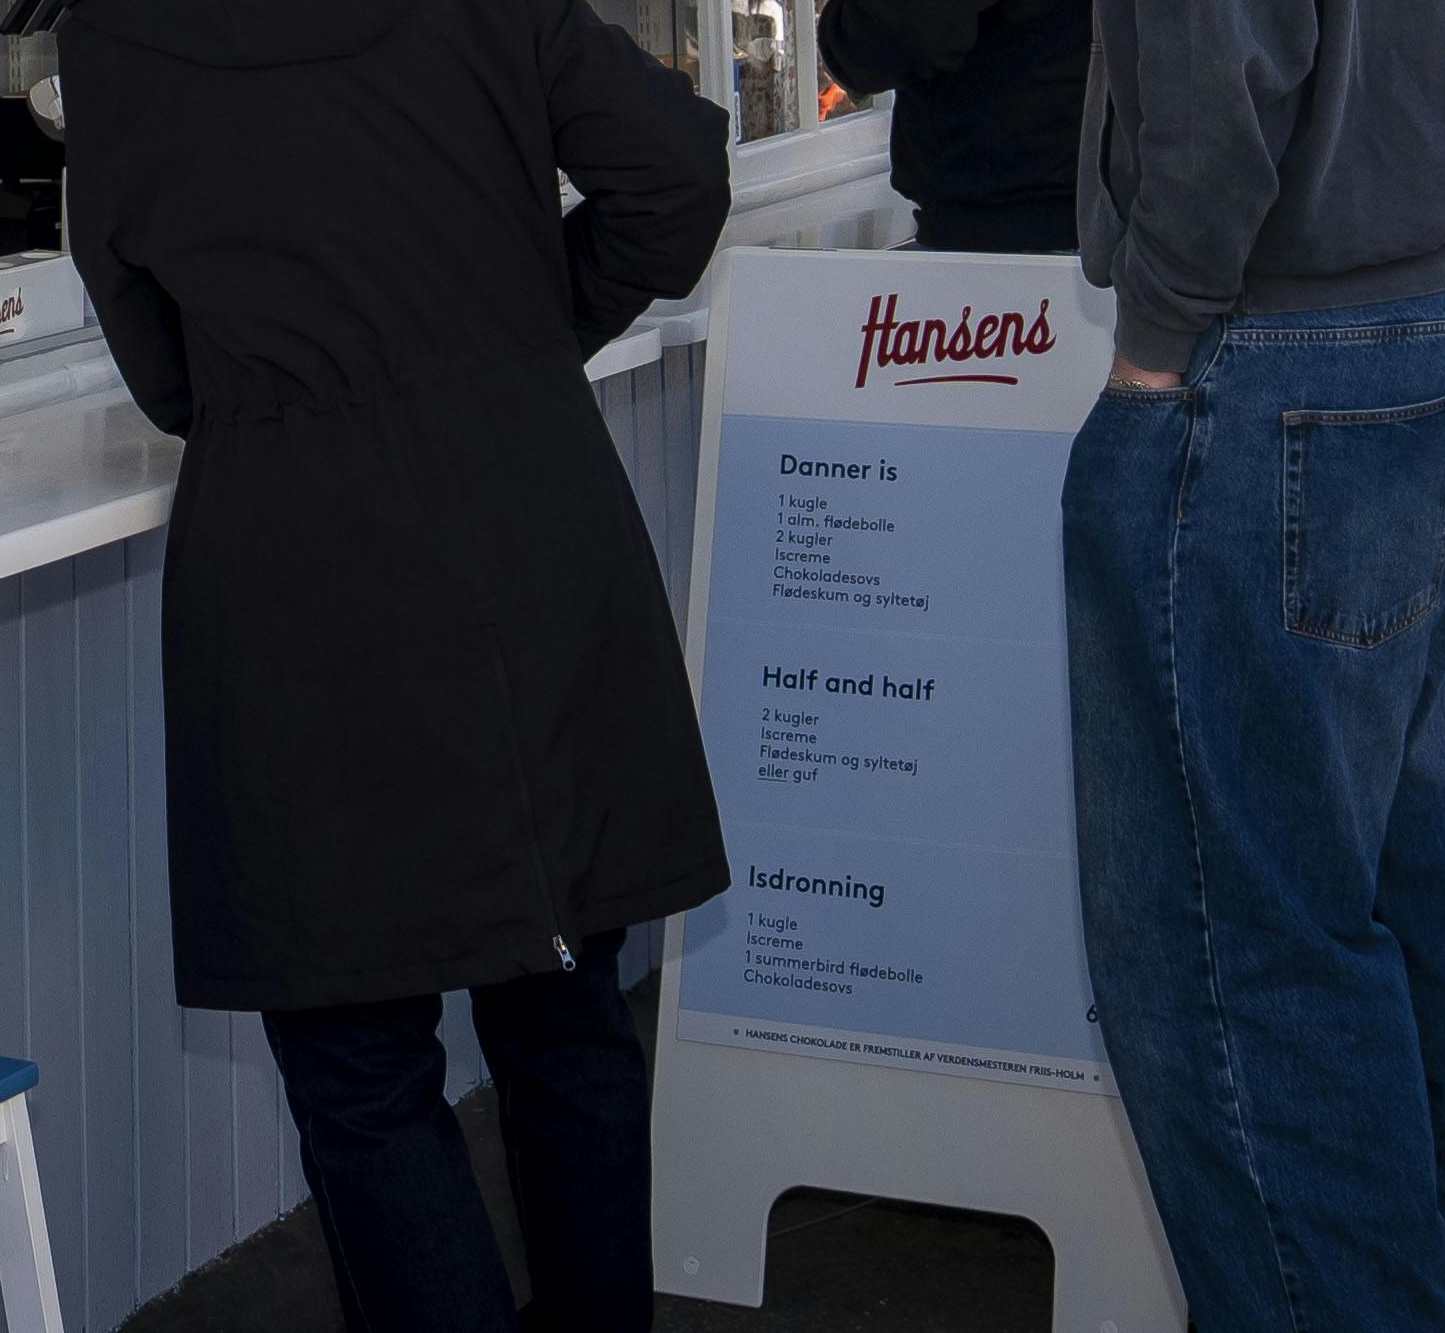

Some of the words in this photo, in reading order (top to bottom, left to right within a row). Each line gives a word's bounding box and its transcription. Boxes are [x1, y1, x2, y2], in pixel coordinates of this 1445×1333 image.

[856, 293, 1057, 388] Hansens
[781, 454, 871, 479] Danner
[880, 459, 897, 481] is
[774, 566, 880, 585] Chokoladesovs
[763, 666, 818, 690] Half
[826, 675, 873, 695] and
[883, 676, 934, 700] half
[750, 865, 884, 907] Isdronning
[746, 950, 750, 963] 1
[756, 955, 844, 974] summerbird
[849, 962, 923, 983] flødebolle
[746, 1029, 788, 1042] HANSENS
[790, 1035, 847, 1050] CHOKOLADE
[850, 1043, 860, 1052] ER
[863, 1044, 921, 1060] FREMSTILLER
[923, 1052, 935, 1061] AF
[937, 1053, 1026, 1073] VERDENSMESTEREN
[1030, 1065, 1084, 1080] FRIIS-HOLM
